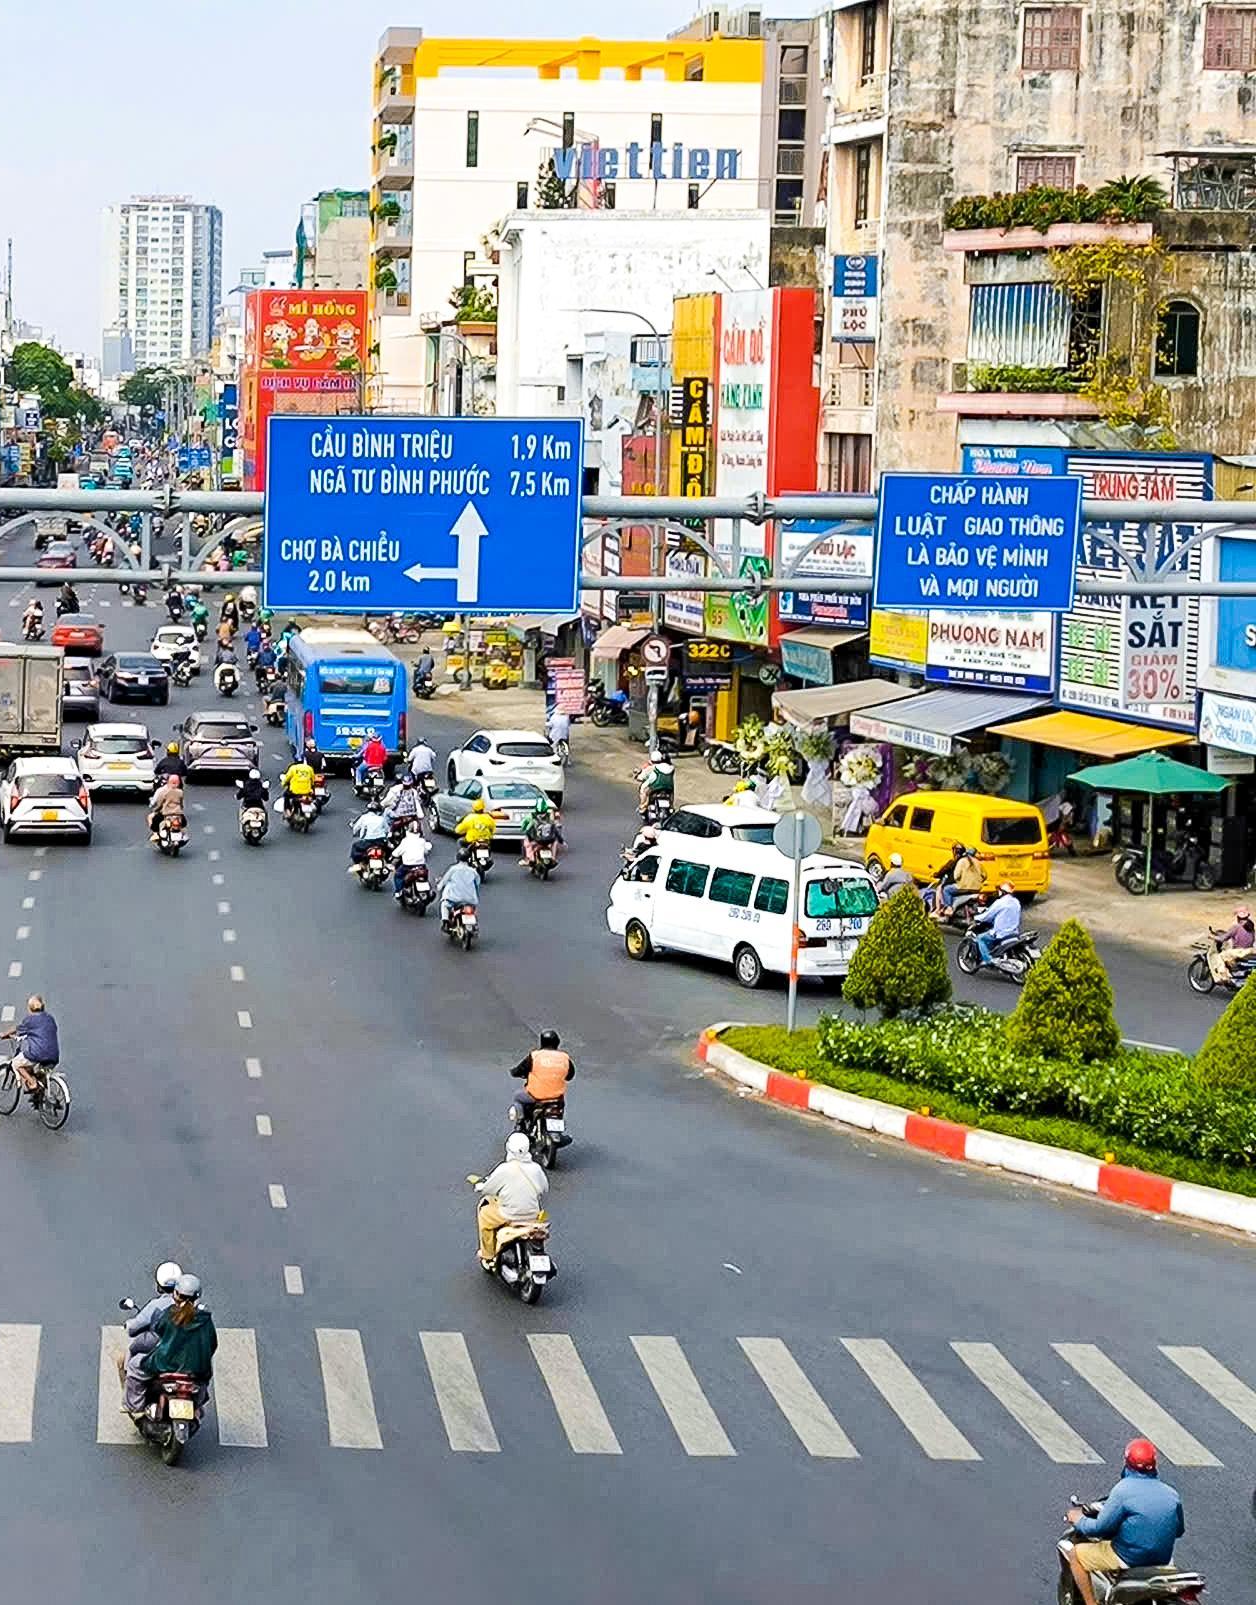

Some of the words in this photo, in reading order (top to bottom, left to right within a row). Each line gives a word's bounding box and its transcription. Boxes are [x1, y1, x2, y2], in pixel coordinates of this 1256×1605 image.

[553, 142, 738, 179] viettien
[311, 424, 346, 458] CẦU
[351, 427, 395, 458] BÌNH
[400, 429, 453, 463] TRIỆU
[542, 434, 572, 460] Km
[310, 465, 346, 494] NGÃ
[352, 468, 376, 494] TƯ
[380, 464, 424, 495] BÌNH
[429, 463, 491, 495] PHƯỚC
[541, 470, 570, 496] Km
[930, 480, 976, 505] CHẤP
[981, 482, 1029, 505] HÀNH
[1092, 471, 1139, 500] TRUNG
[1144, 468, 1176, 501] TÂM
[895, 512, 948, 539] LUẬT
[964, 516, 1004, 536] GIAO
[1009, 515, 1064, 536] THÔNG
[281, 538, 317, 567] CHỢ
[321, 536, 344, 561] BÀ
[348, 530, 400, 562] CHIỂU
[906, 543, 930, 566] LÀ
[935, 541, 969, 566] BẢO
[975, 546, 998, 570] VỆ
[1002, 546, 1049, 567] MÌNH
[341, 570, 371, 592] km
[919, 573, 941, 598] VÀ
[947, 578, 979, 601] MỌI
[985, 573, 1039, 599] NGƯỜI
[1005, 629, 1045, 649] NAM
[1127, 610, 1183, 649] SẮT
[688, 643, 731, 658] 322C
[1131, 651, 1179, 666] GIẢM
[1127, 669, 1181, 700] 30%
